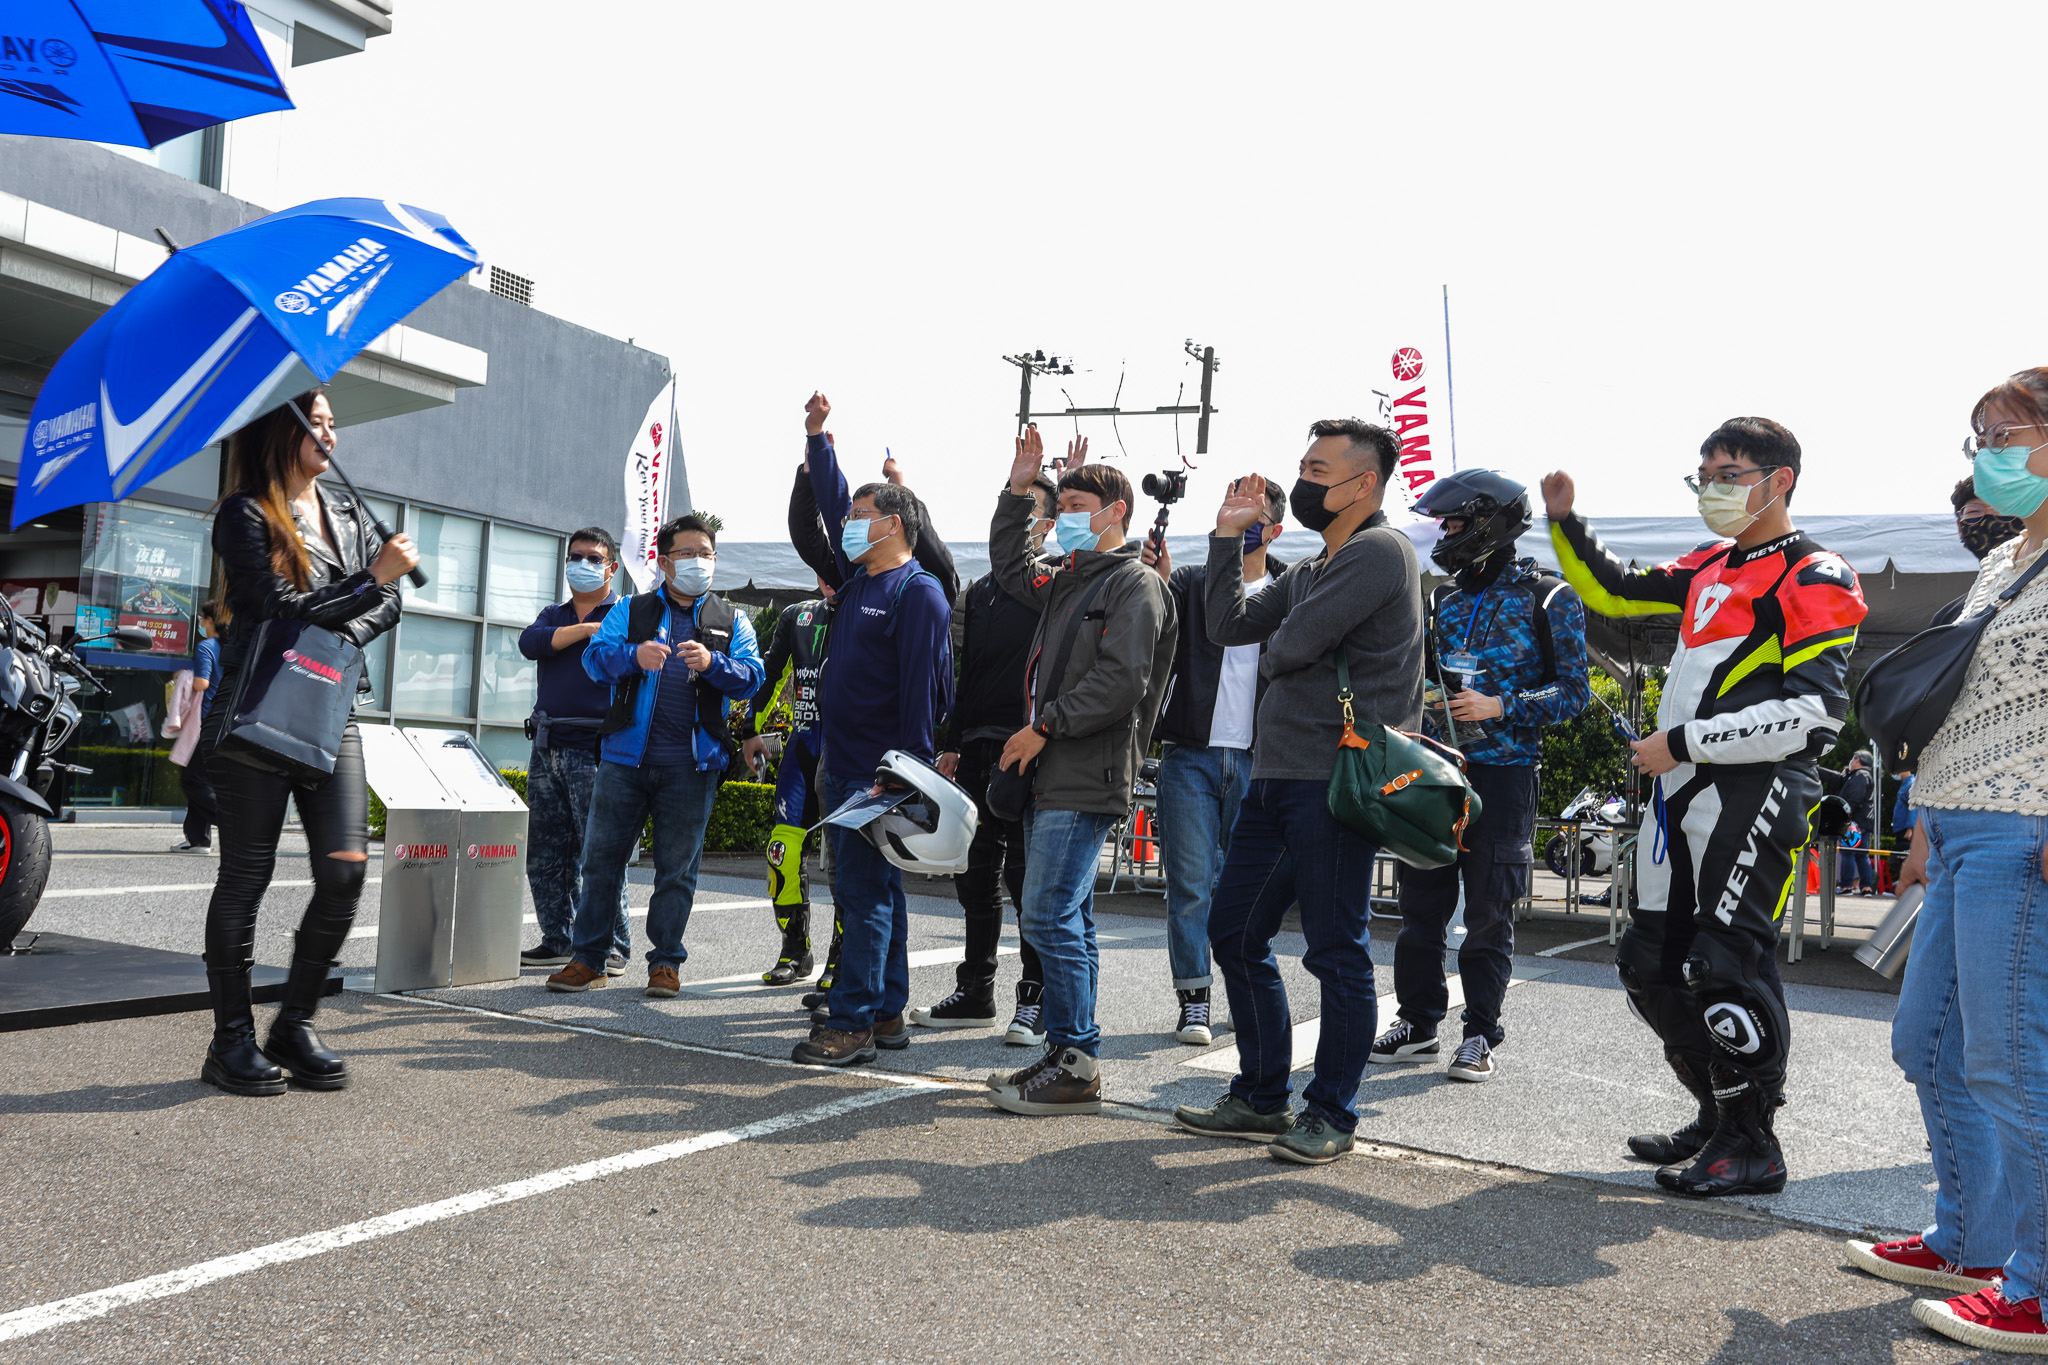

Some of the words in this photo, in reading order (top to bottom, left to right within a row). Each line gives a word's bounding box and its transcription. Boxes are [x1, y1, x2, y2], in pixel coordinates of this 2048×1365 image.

[291, 237, 388, 298] YAMAHA
[302, 253, 390, 316] RACING
[48, 402, 97, 443] YAMAHA
[36, 432, 93, 457] RACING
[1393, 386, 1436, 500] YAMA
[135, 545, 166, 564] 夜練
[298, 654, 342, 684] YAMAHA
[794, 700, 818, 711] SEM
[1700, 717, 1801, 745] REV'IT!
[407, 844, 449, 859] YAMAHA
[479, 844, 518, 859] YAMAHA
[1714, 775, 1789, 927] REV'IT!
